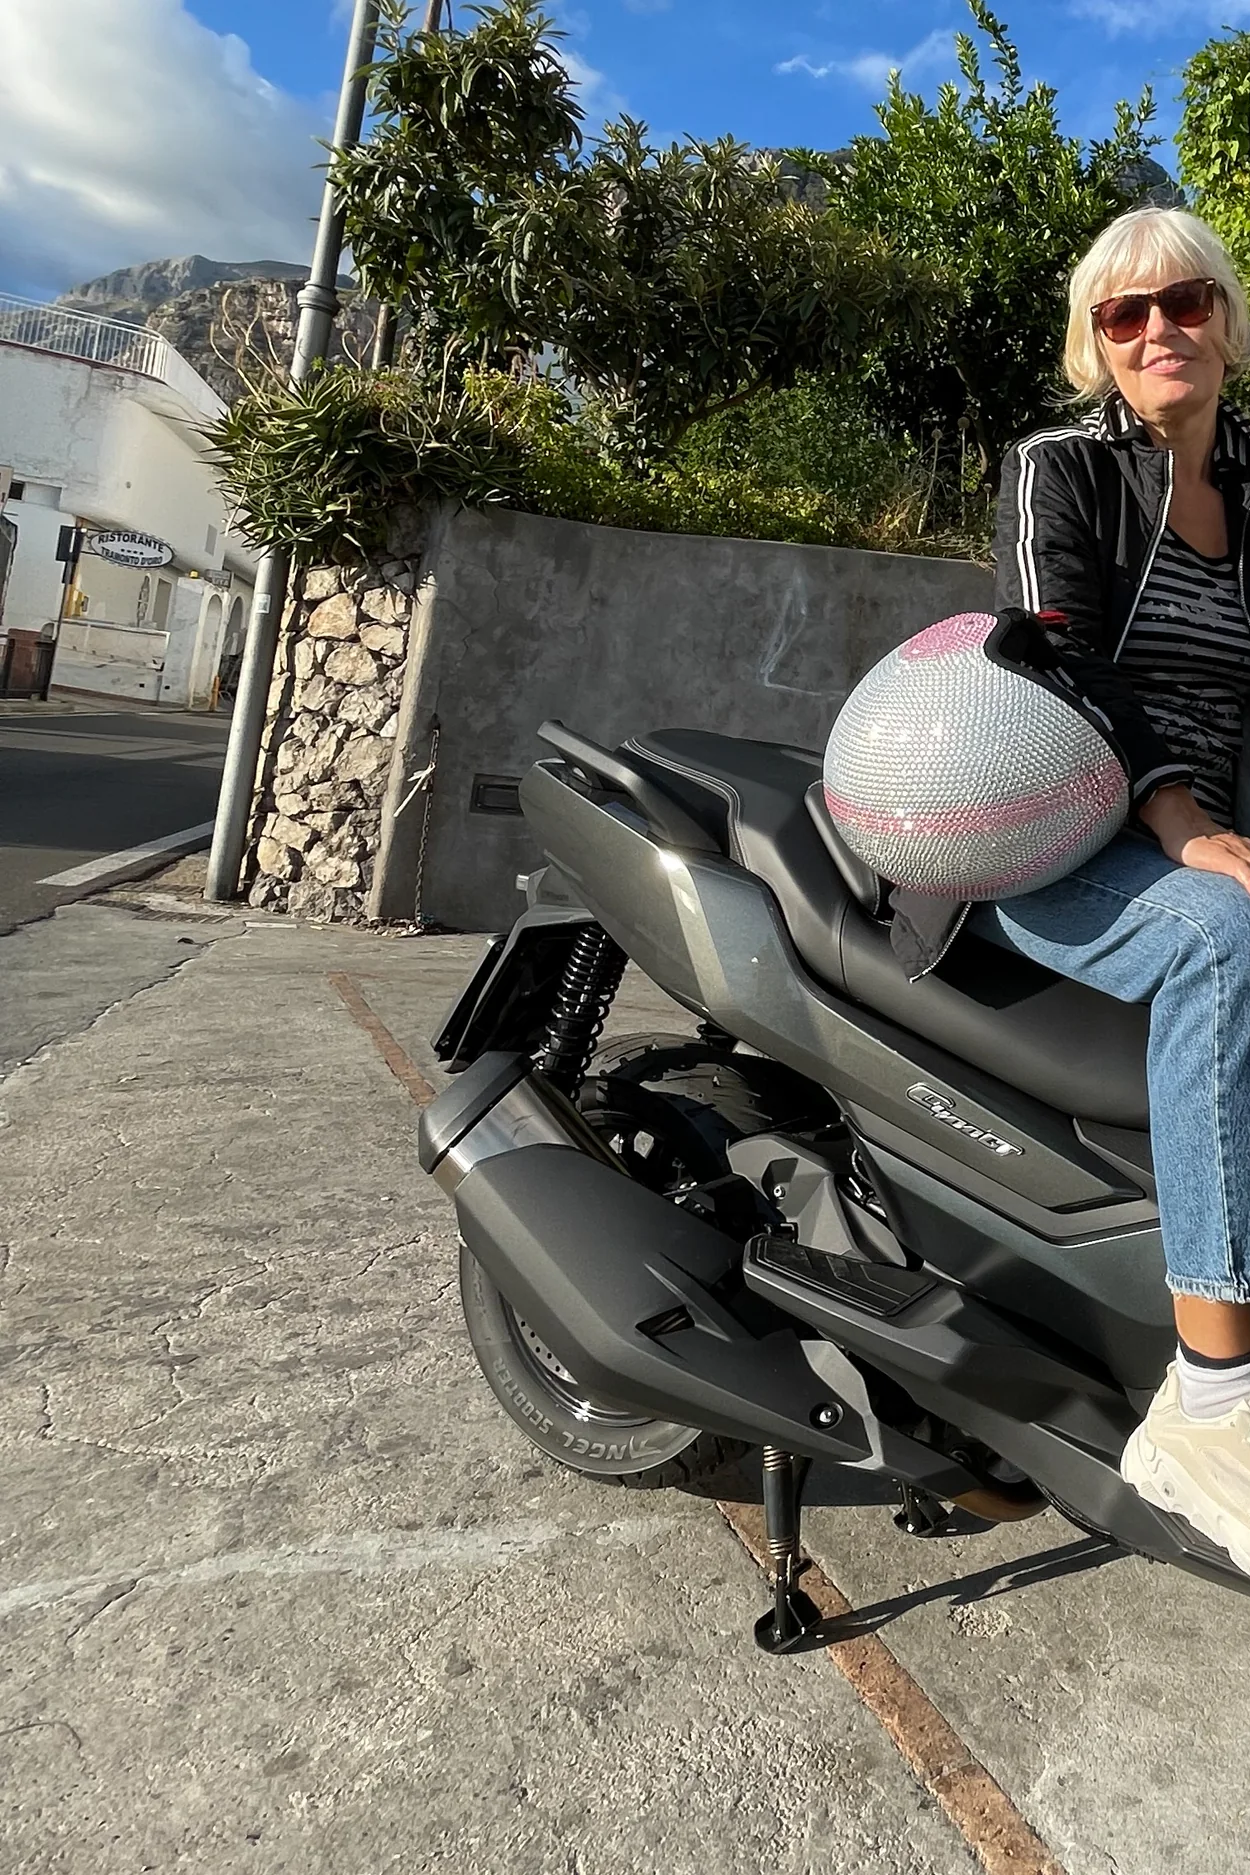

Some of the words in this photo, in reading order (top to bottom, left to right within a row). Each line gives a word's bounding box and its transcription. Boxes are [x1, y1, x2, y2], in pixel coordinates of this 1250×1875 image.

[98, 532, 164, 553] RISTORANTE
[101, 546, 139, 565] TRAMONTO
[140, 556, 163, 566] D'ORO
[492, 1357, 554, 1435] SCOOTER
